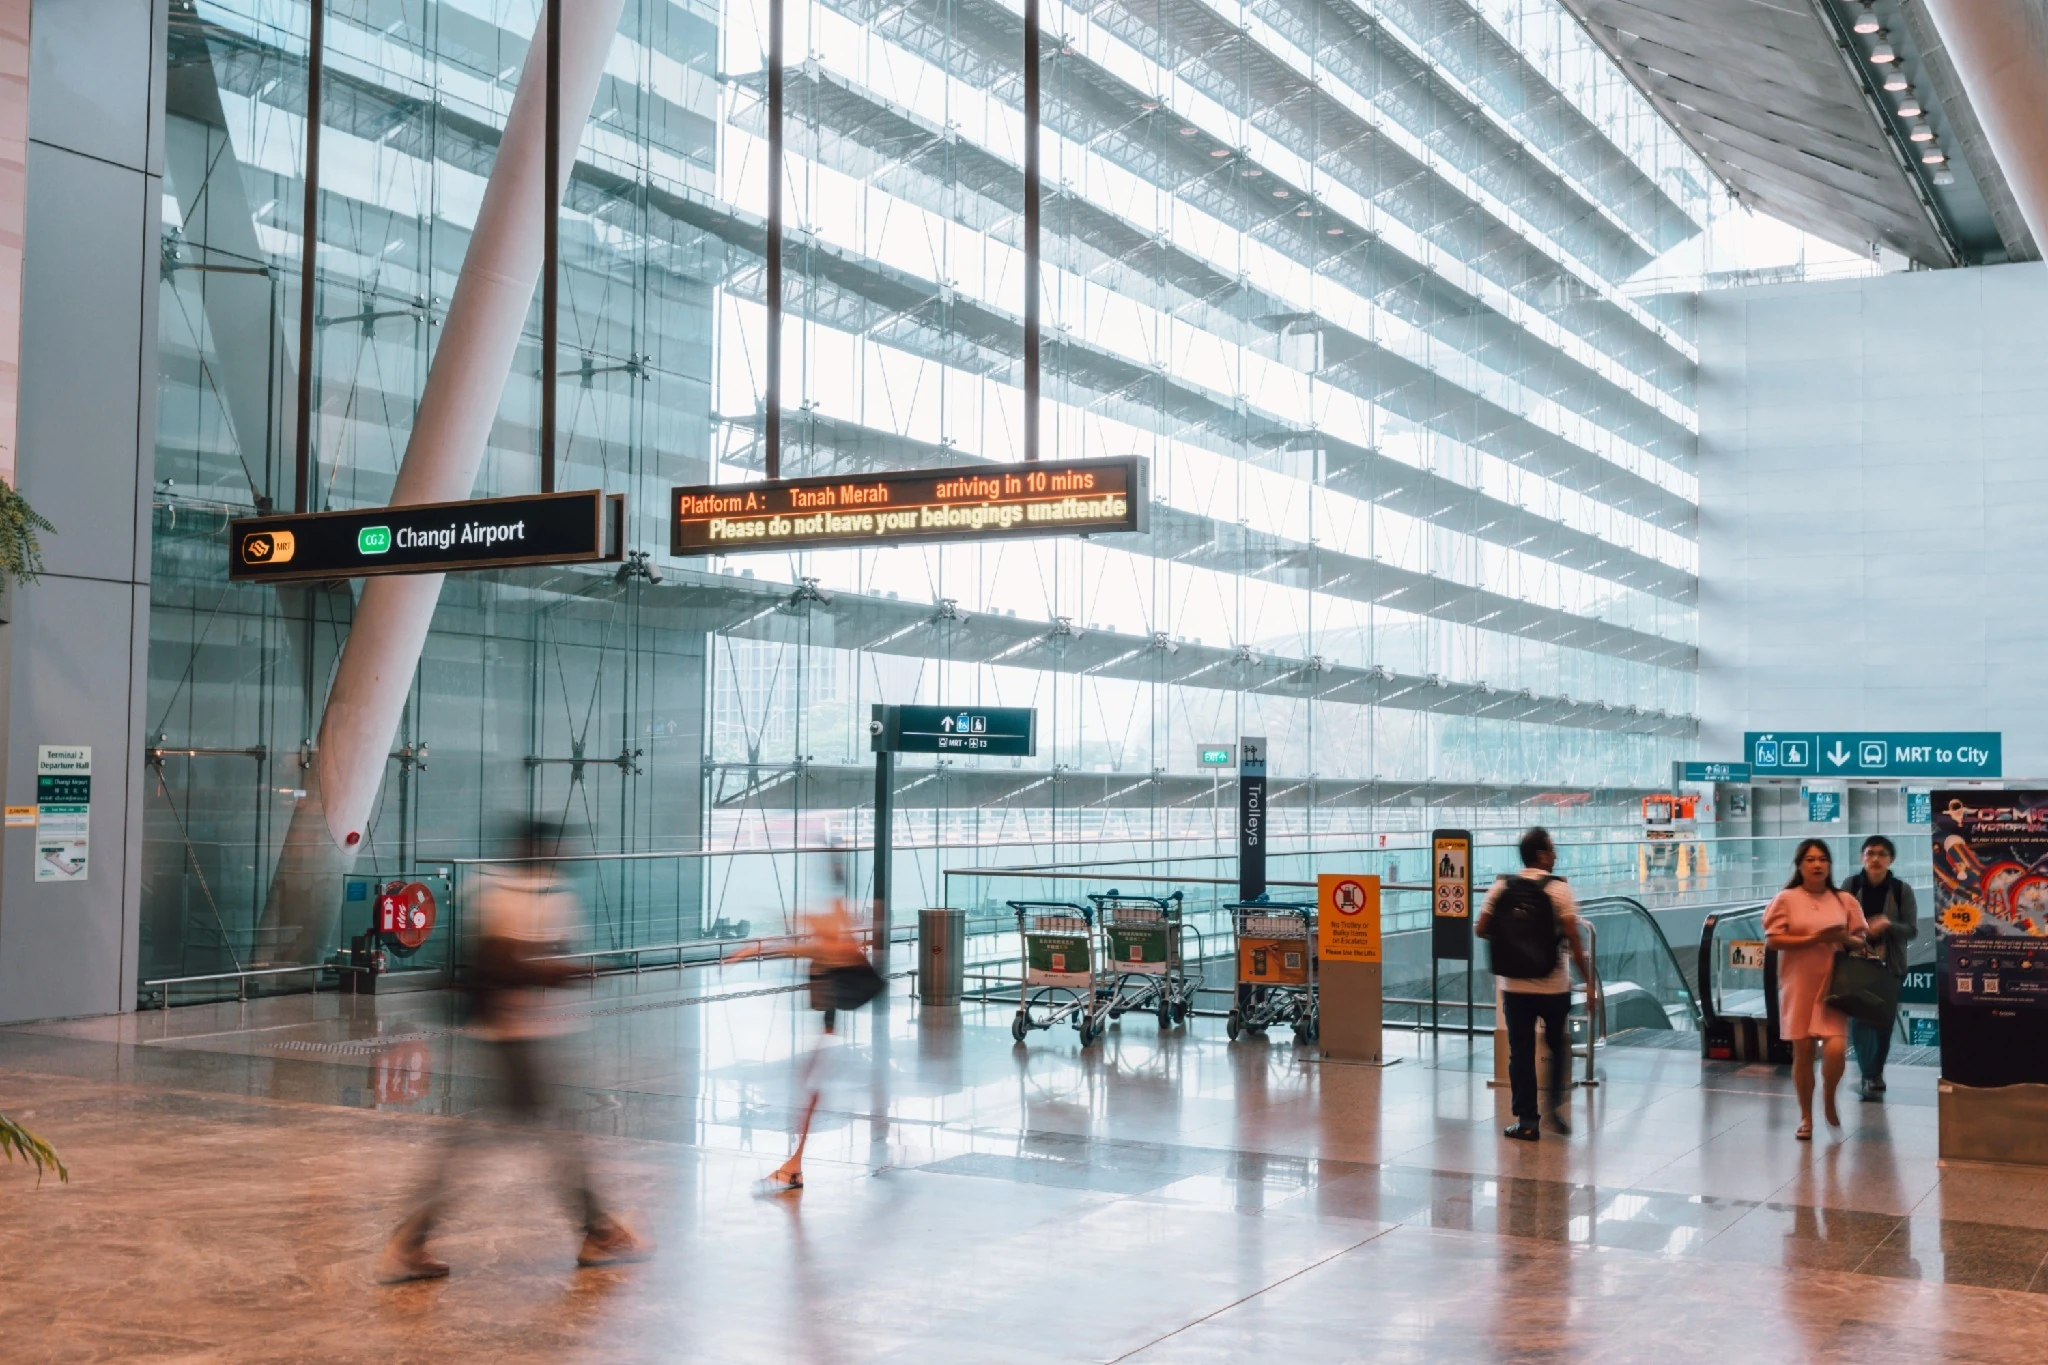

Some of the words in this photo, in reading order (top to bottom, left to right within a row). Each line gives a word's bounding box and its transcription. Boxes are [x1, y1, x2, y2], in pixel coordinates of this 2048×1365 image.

[681, 494, 742, 515] Platform
[789, 486, 835, 507] Tanah
[840, 483, 888, 505] Merah
[936, 476, 1000, 499] arriving
[1005, 473, 1021, 493] in
[1026, 472, 1046, 492] 10
[1051, 470, 1094, 490] mins
[709, 519, 767, 539] Please
[768, 515, 791, 535] do
[794, 514, 824, 534] not
[825, 512, 873, 532] leave
[875, 511, 918, 534] your
[921, 503, 1023, 528] belongings
[1027, 495, 1127, 520] unattende
[396, 524, 456, 549] Changi
[460, 520, 525, 547] Airport
[276, 542, 291, 551] MRT
[979, 740, 987, 748] T3
[48, 751, 76, 759] Terminal
[1204, 752, 1219, 762] EXIT
[1895, 746, 1931, 763] MRT
[1936, 747, 1952, 762] to
[1956, 746, 1989, 766] City
[41, 762, 74, 770] Departure
[1245, 783, 1262, 846] Trolleys
[1331, 921, 1340, 929] No
[1341, 921, 1361, 931] Trolley
[1333, 929, 1350, 938] Bulky
[1341, 937, 1368, 945] Escalator
